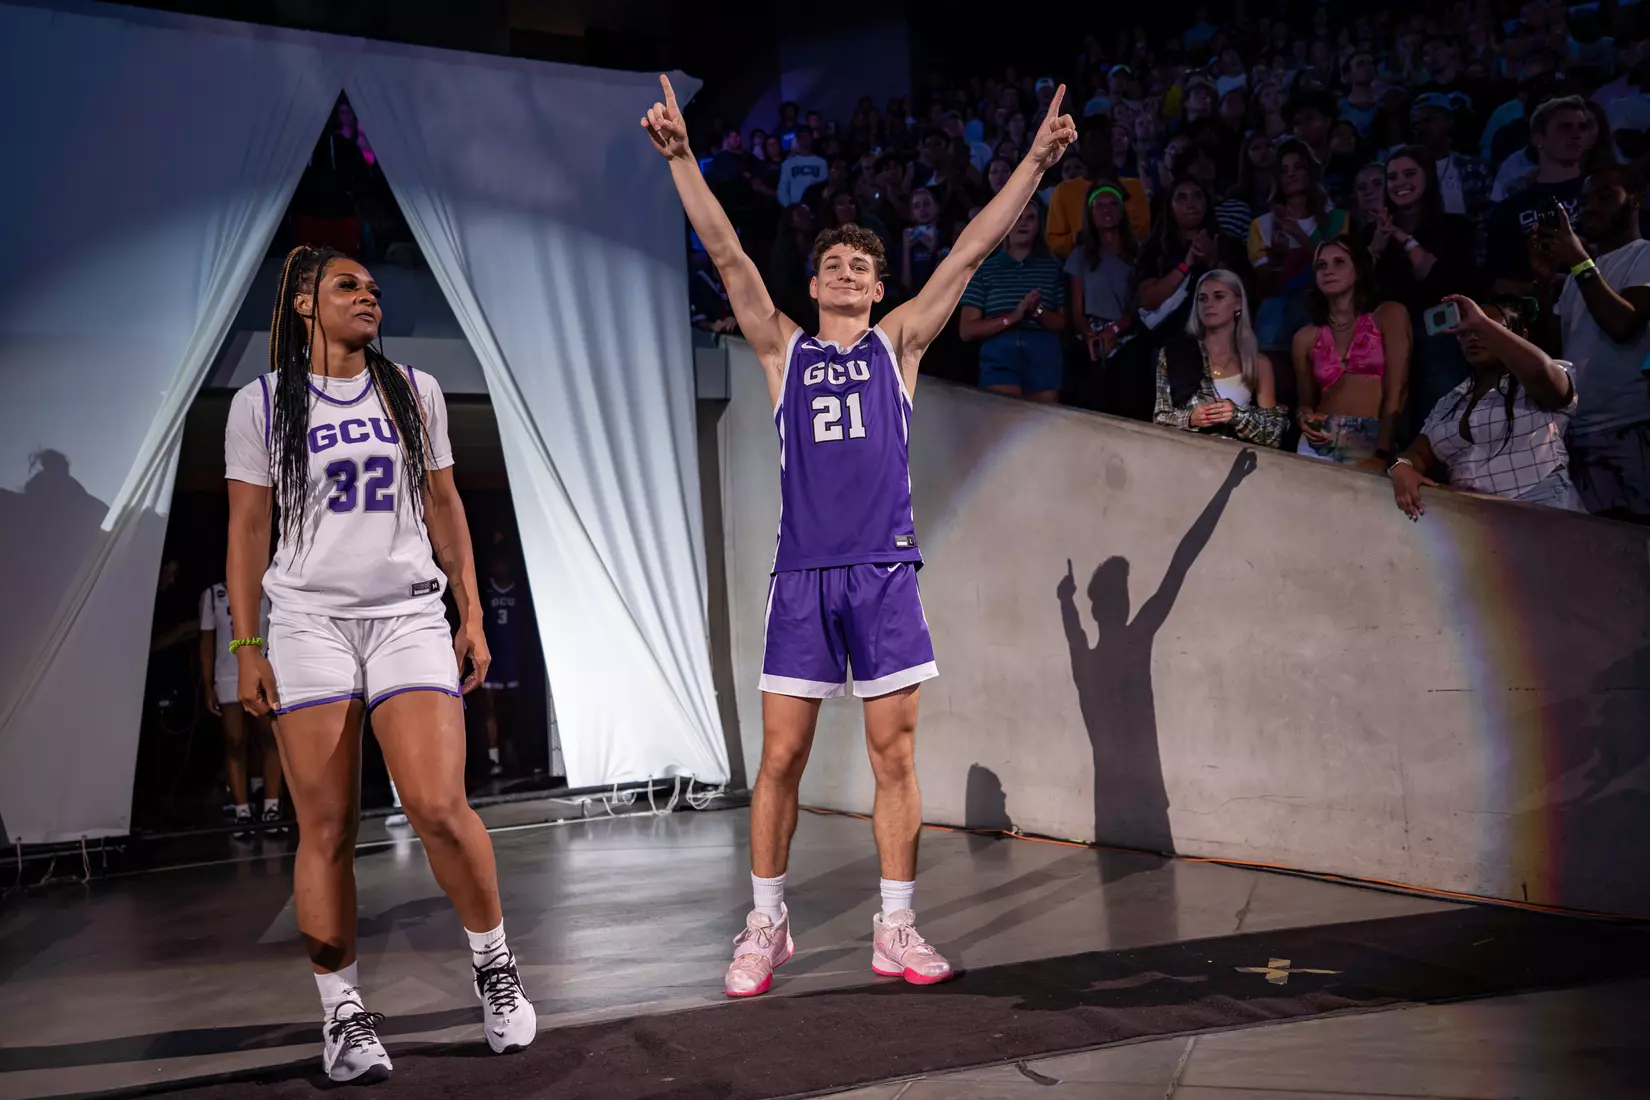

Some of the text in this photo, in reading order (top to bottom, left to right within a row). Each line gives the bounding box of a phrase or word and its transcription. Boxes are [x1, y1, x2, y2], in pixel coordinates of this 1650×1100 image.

[803, 360, 871, 386] GCU
[308, 418, 400, 453] GCU
[811, 392, 867, 444] 21
[324, 454, 396, 515] 32
[497, 608, 509, 625] 3
